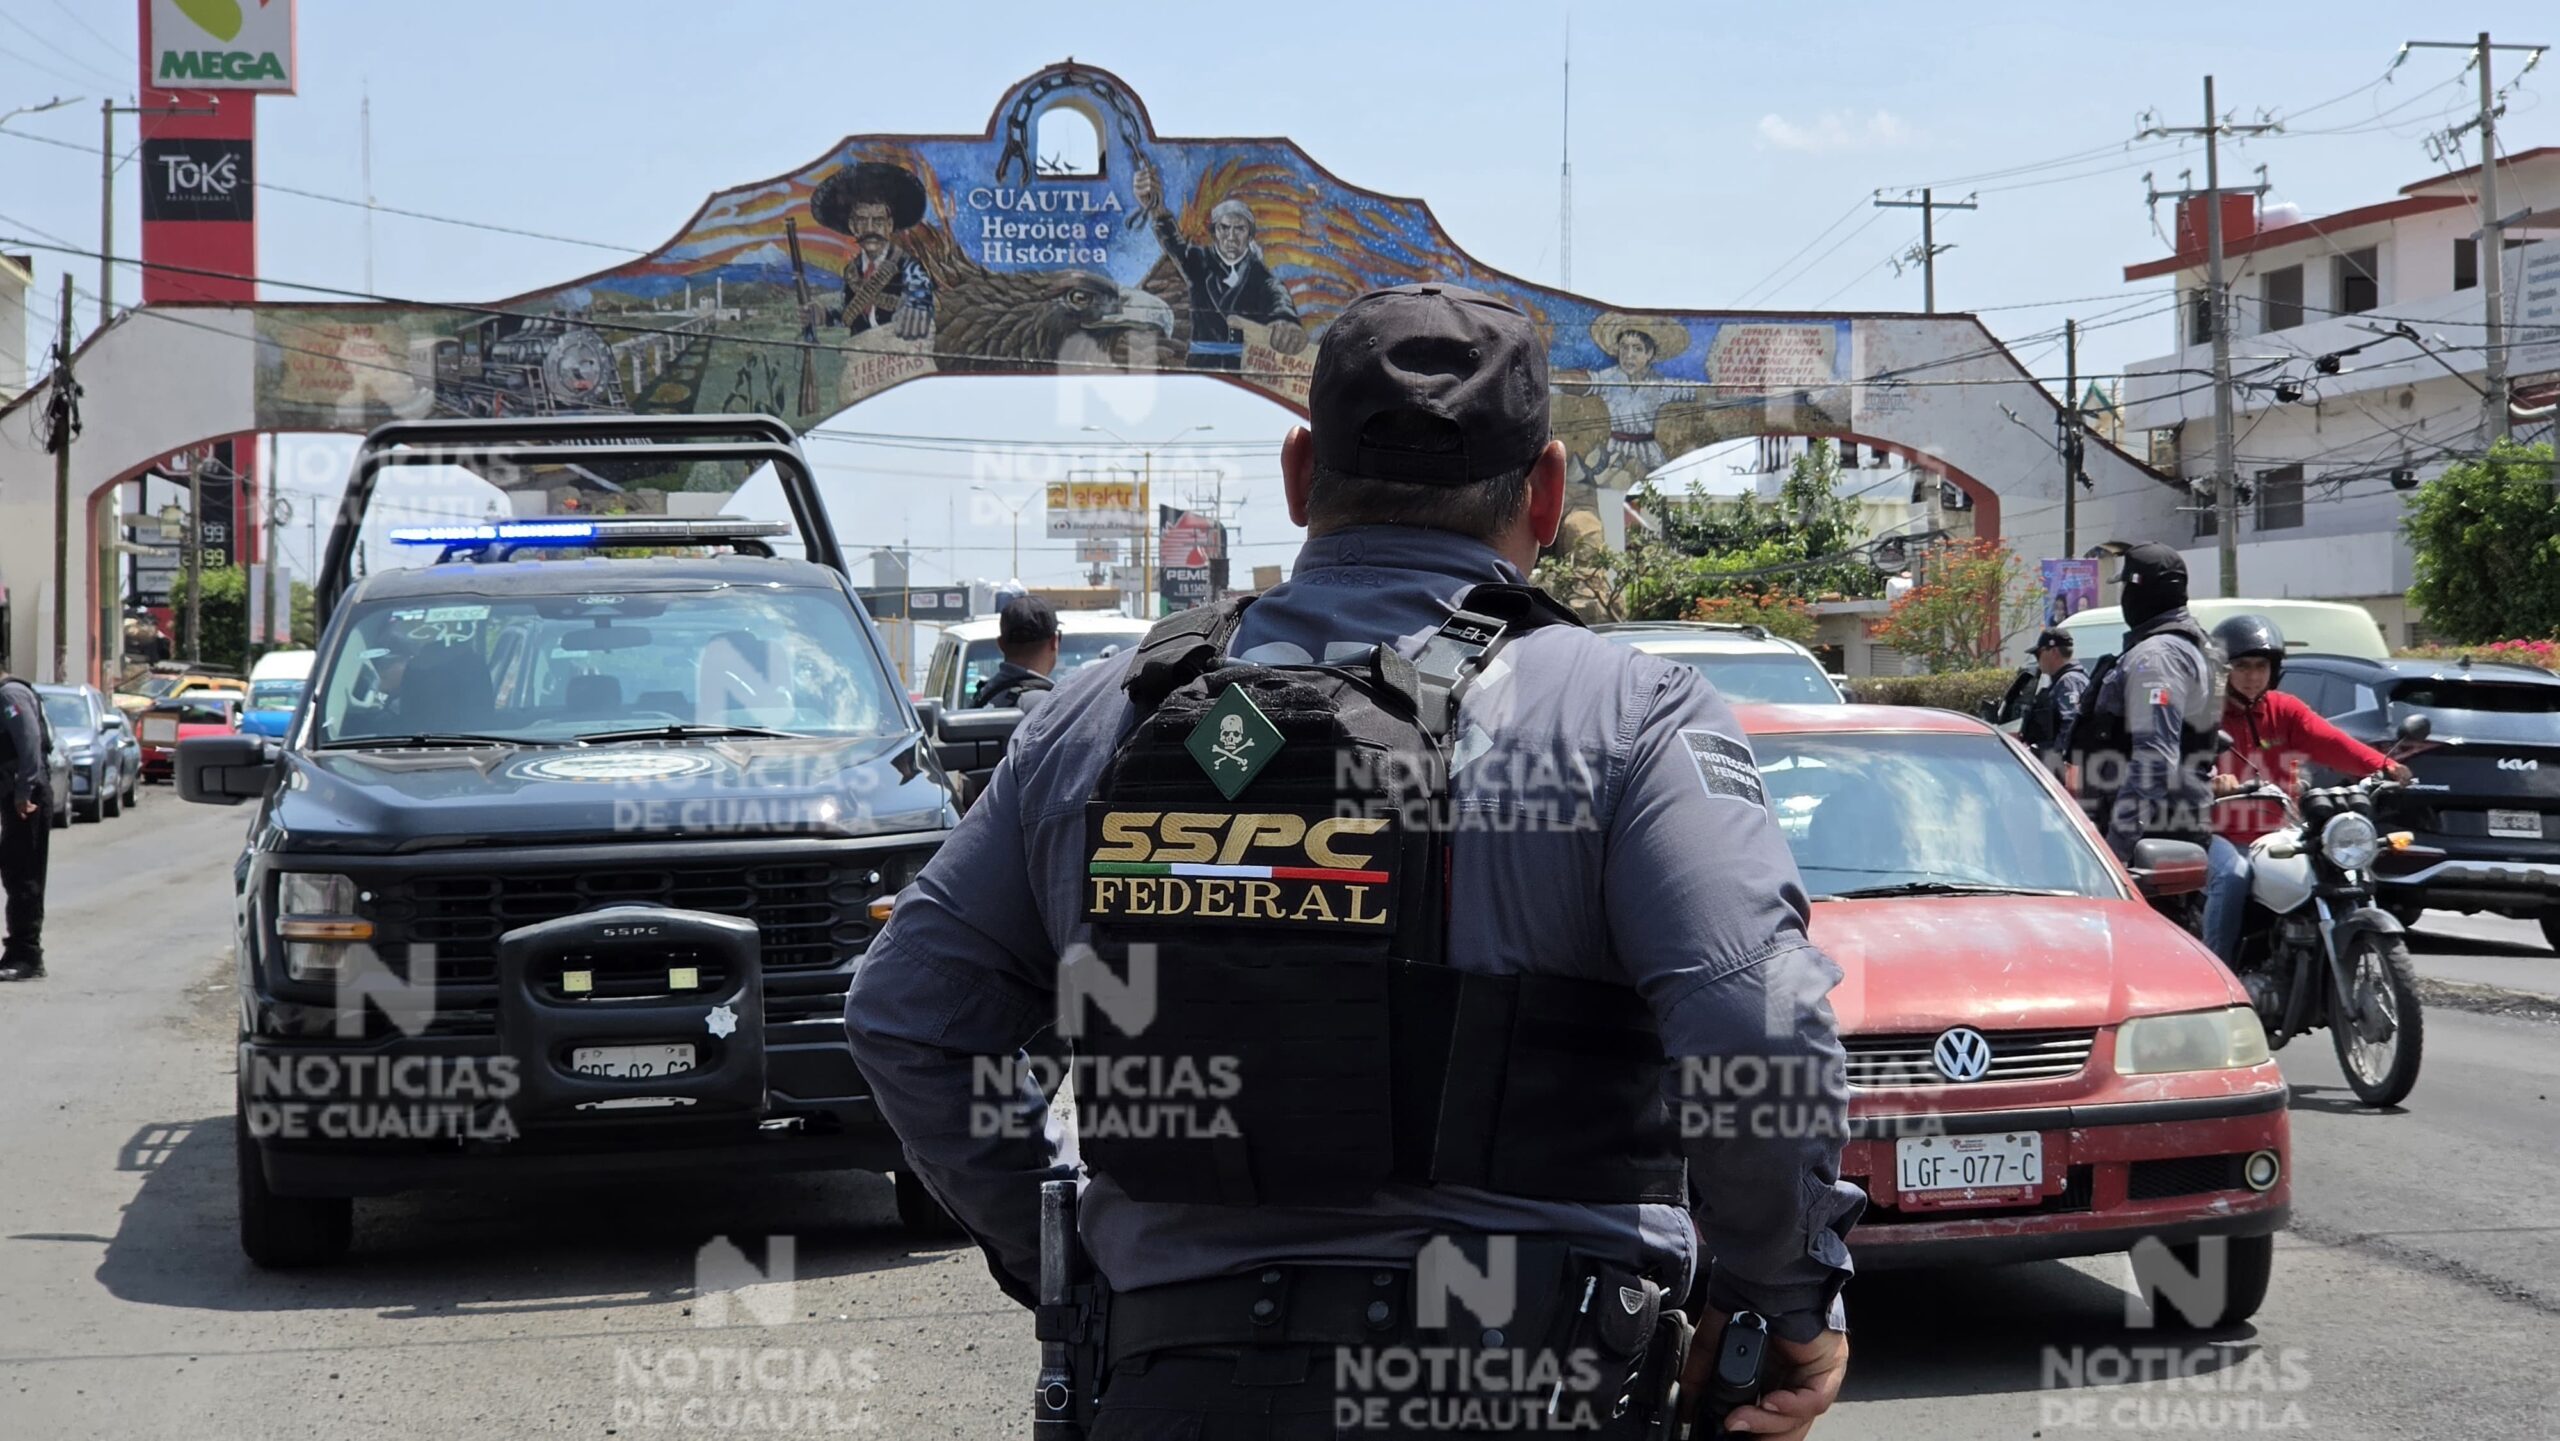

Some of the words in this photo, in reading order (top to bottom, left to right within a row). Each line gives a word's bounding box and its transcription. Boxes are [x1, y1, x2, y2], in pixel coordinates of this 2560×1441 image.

[159, 50, 286, 81] MEGA
[968, 188, 1122, 212] CUAUTLA
[1094, 222, 1110, 239] e
[981, 241, 1107, 264] Histórica
[852, 358, 924, 391] LIBERTAD
[1167, 570, 1209, 581] PEME
[1092, 812, 1390, 869] SSPC
[1090, 877, 1388, 925] FEDERAL
[603, 927, 659, 936] SSPC
[1903, 1153, 2035, 1187] LGF-077-C
